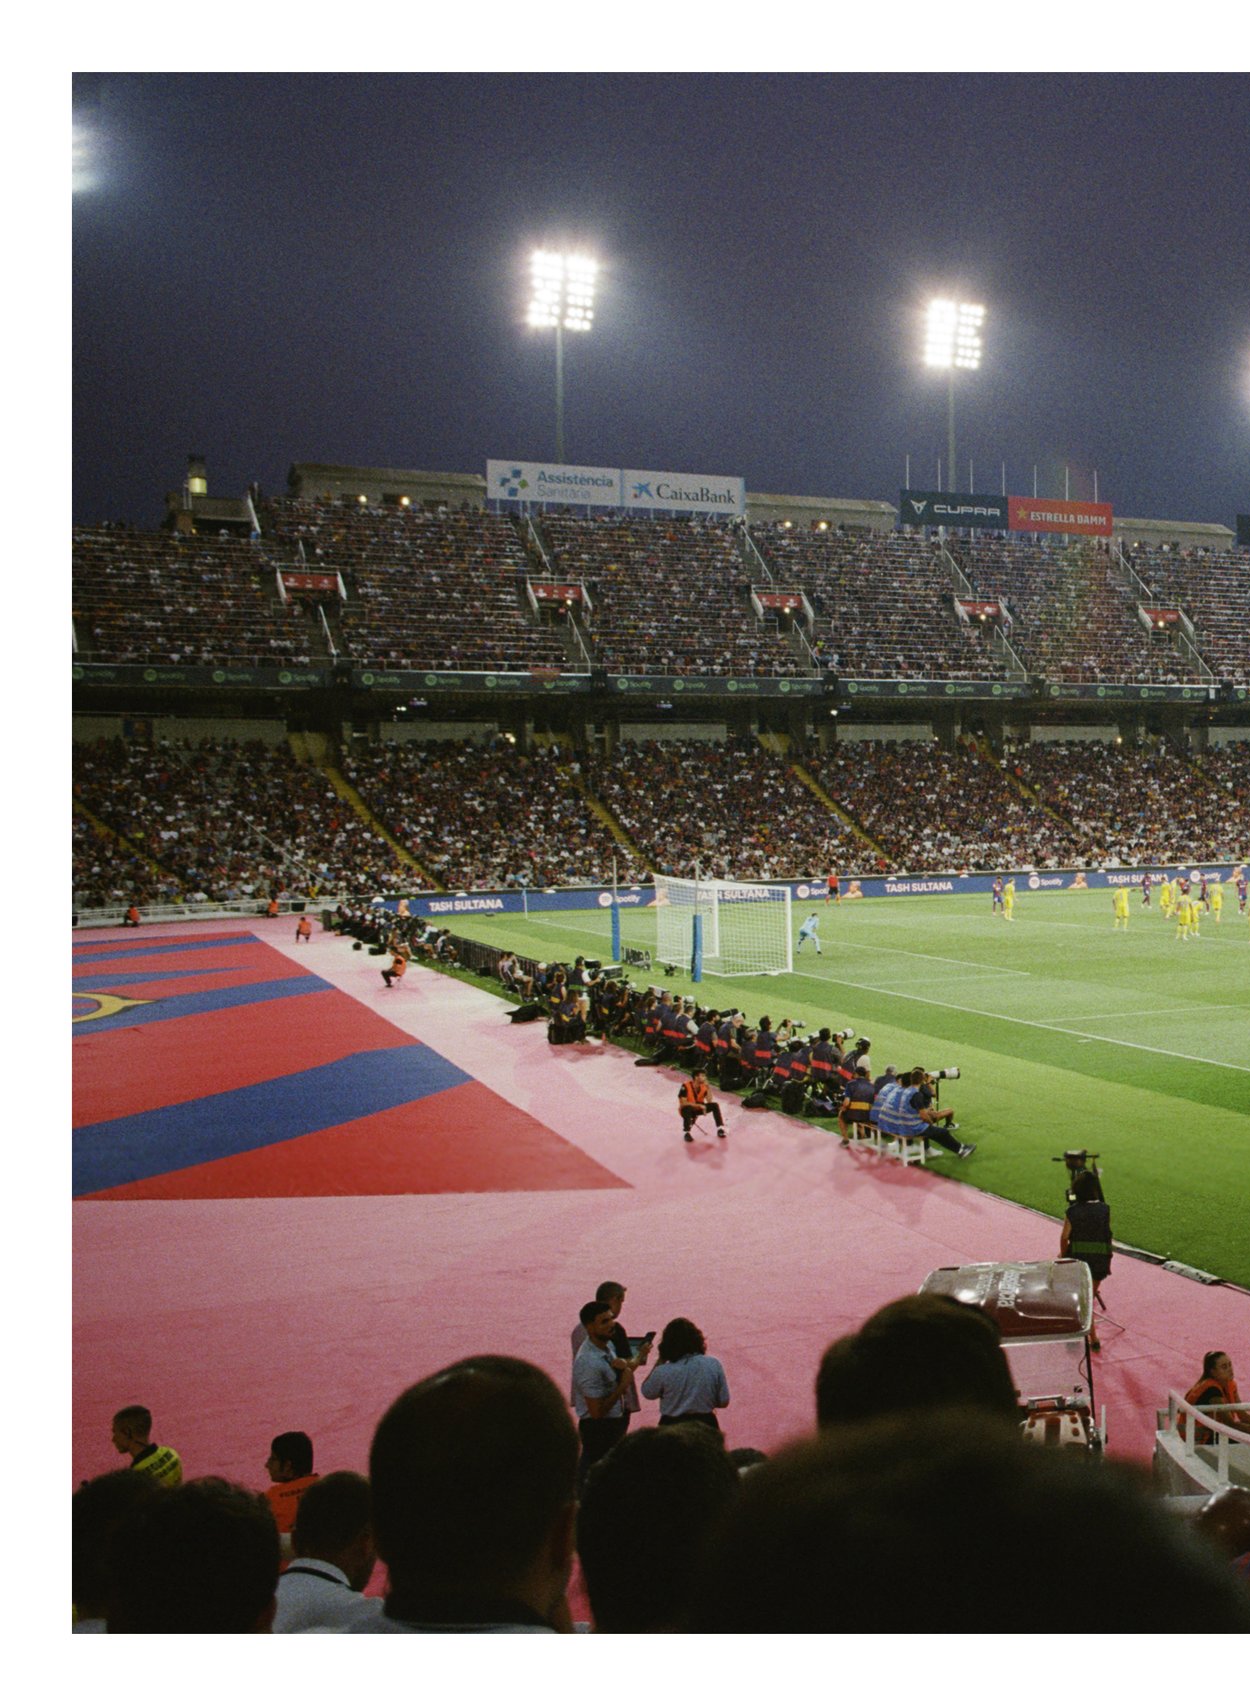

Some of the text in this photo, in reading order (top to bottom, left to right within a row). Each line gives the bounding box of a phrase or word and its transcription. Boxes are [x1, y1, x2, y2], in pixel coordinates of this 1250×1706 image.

[657, 483, 736, 504] CaixaBank
[934, 504, 1000, 516] CUPRA
[1030, 511, 1106, 525] ESTRELLA DAMM
[1107, 875, 1131, 884] TASH
[885, 881, 953, 893] TASH SULTANA
[429, 899, 504, 912] TASH SULTANA
